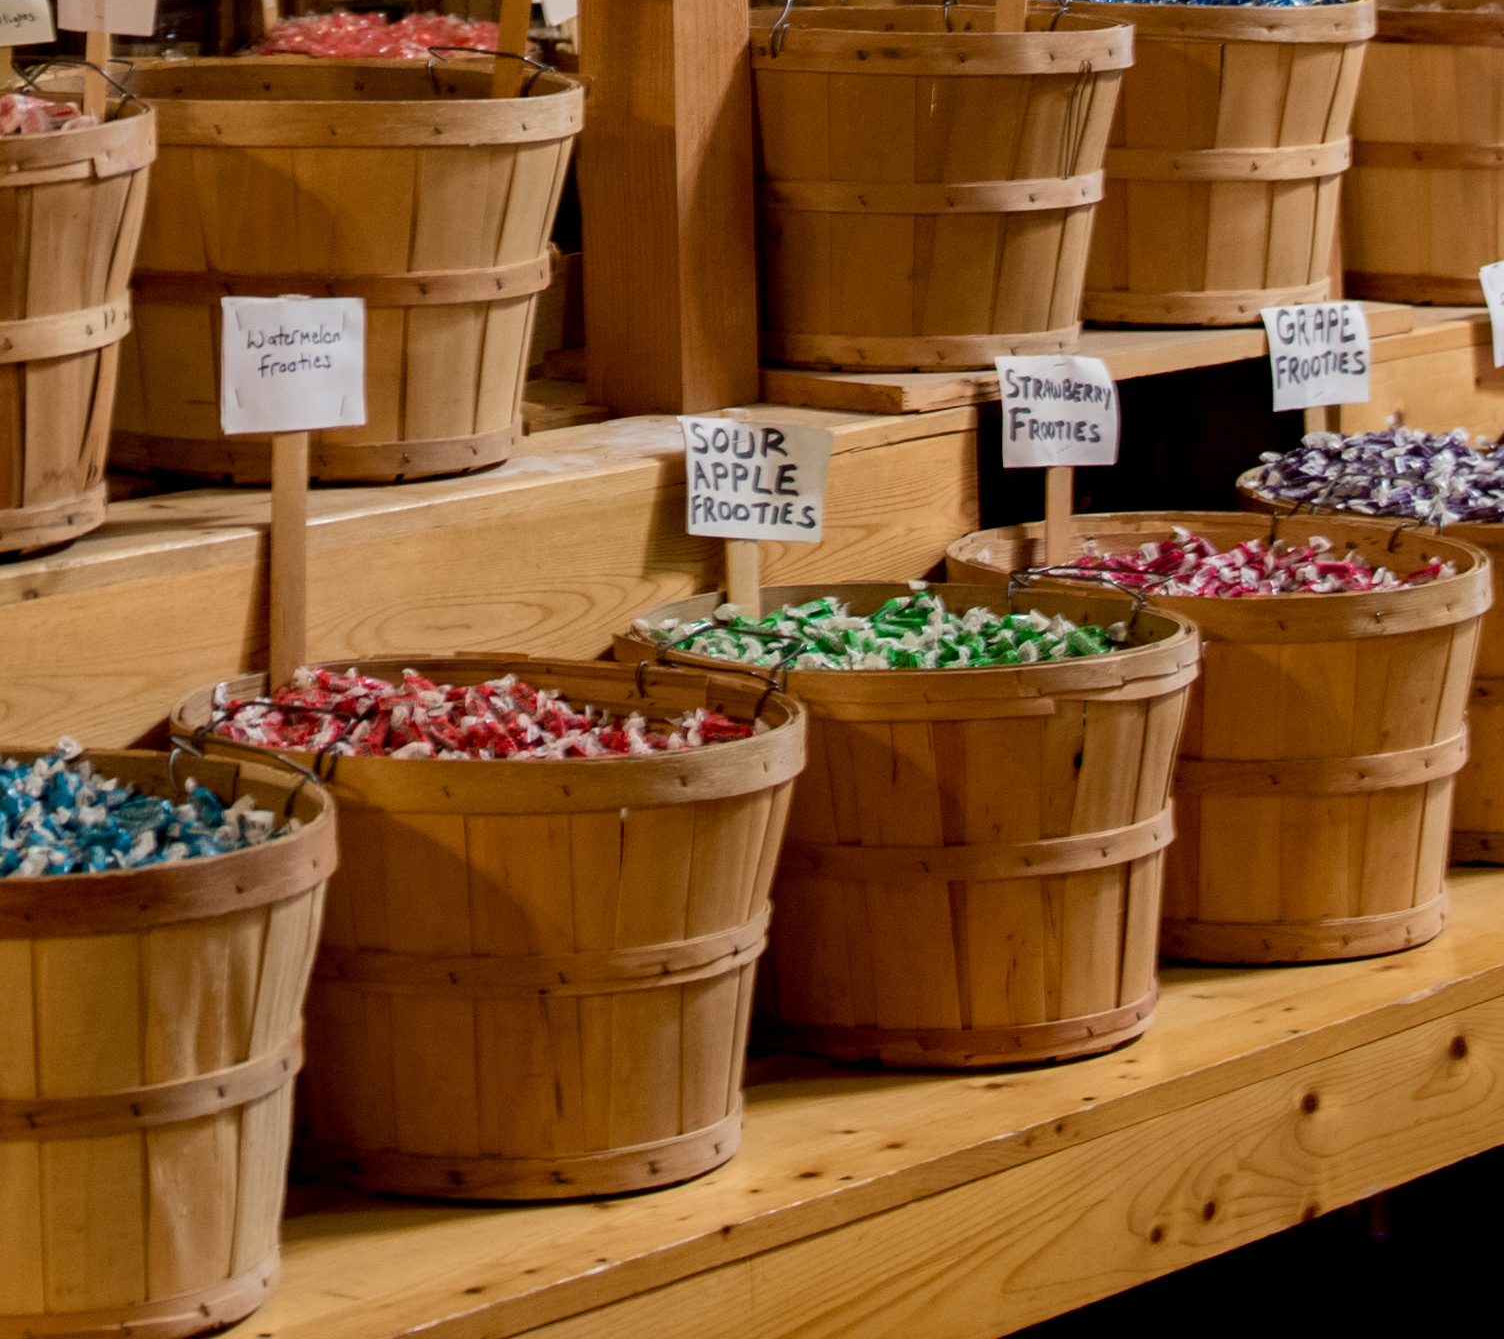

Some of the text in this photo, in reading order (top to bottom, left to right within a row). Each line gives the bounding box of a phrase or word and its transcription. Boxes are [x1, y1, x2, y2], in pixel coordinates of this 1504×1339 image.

[1276, 305, 1355, 347] GRAPE
[1276, 349, 1366, 390] FROOTIES
[1004, 369, 1113, 411] STRAWBERRY
[689, 422, 788, 459] SOUR
[1009, 407, 1101, 443] FROOTIES
[692, 461, 799, 497] APPLE
[691, 497, 816, 530] FROOTIES
